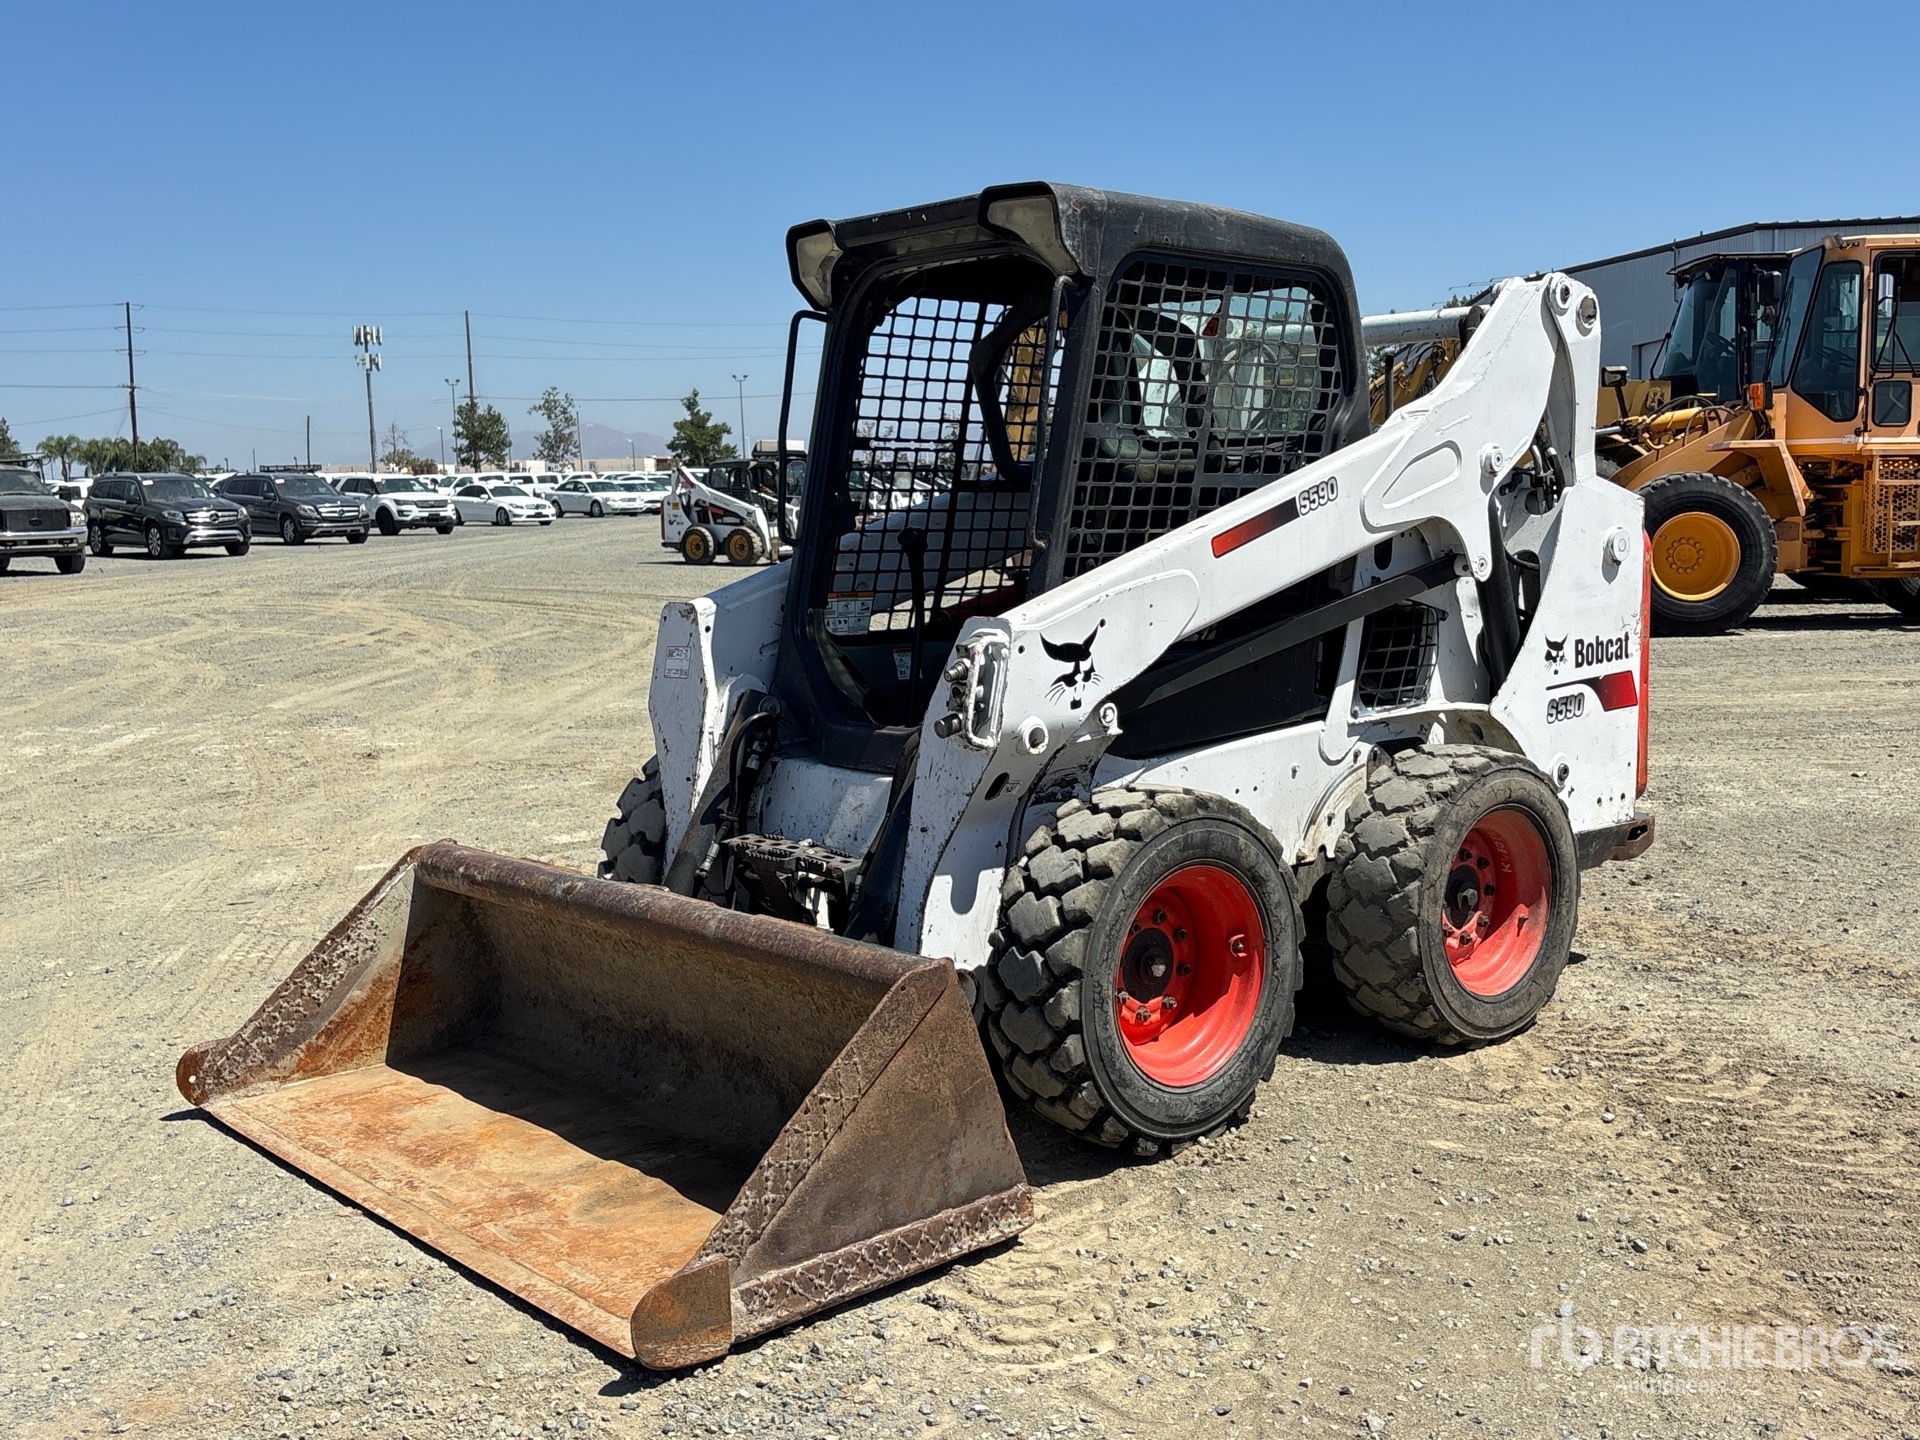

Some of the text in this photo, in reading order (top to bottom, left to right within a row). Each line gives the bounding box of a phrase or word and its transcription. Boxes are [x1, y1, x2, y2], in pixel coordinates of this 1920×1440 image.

[1300, 476, 1339, 516] S590
[1575, 631, 1630, 669] Bobcat
[1546, 692, 1585, 724] S590
